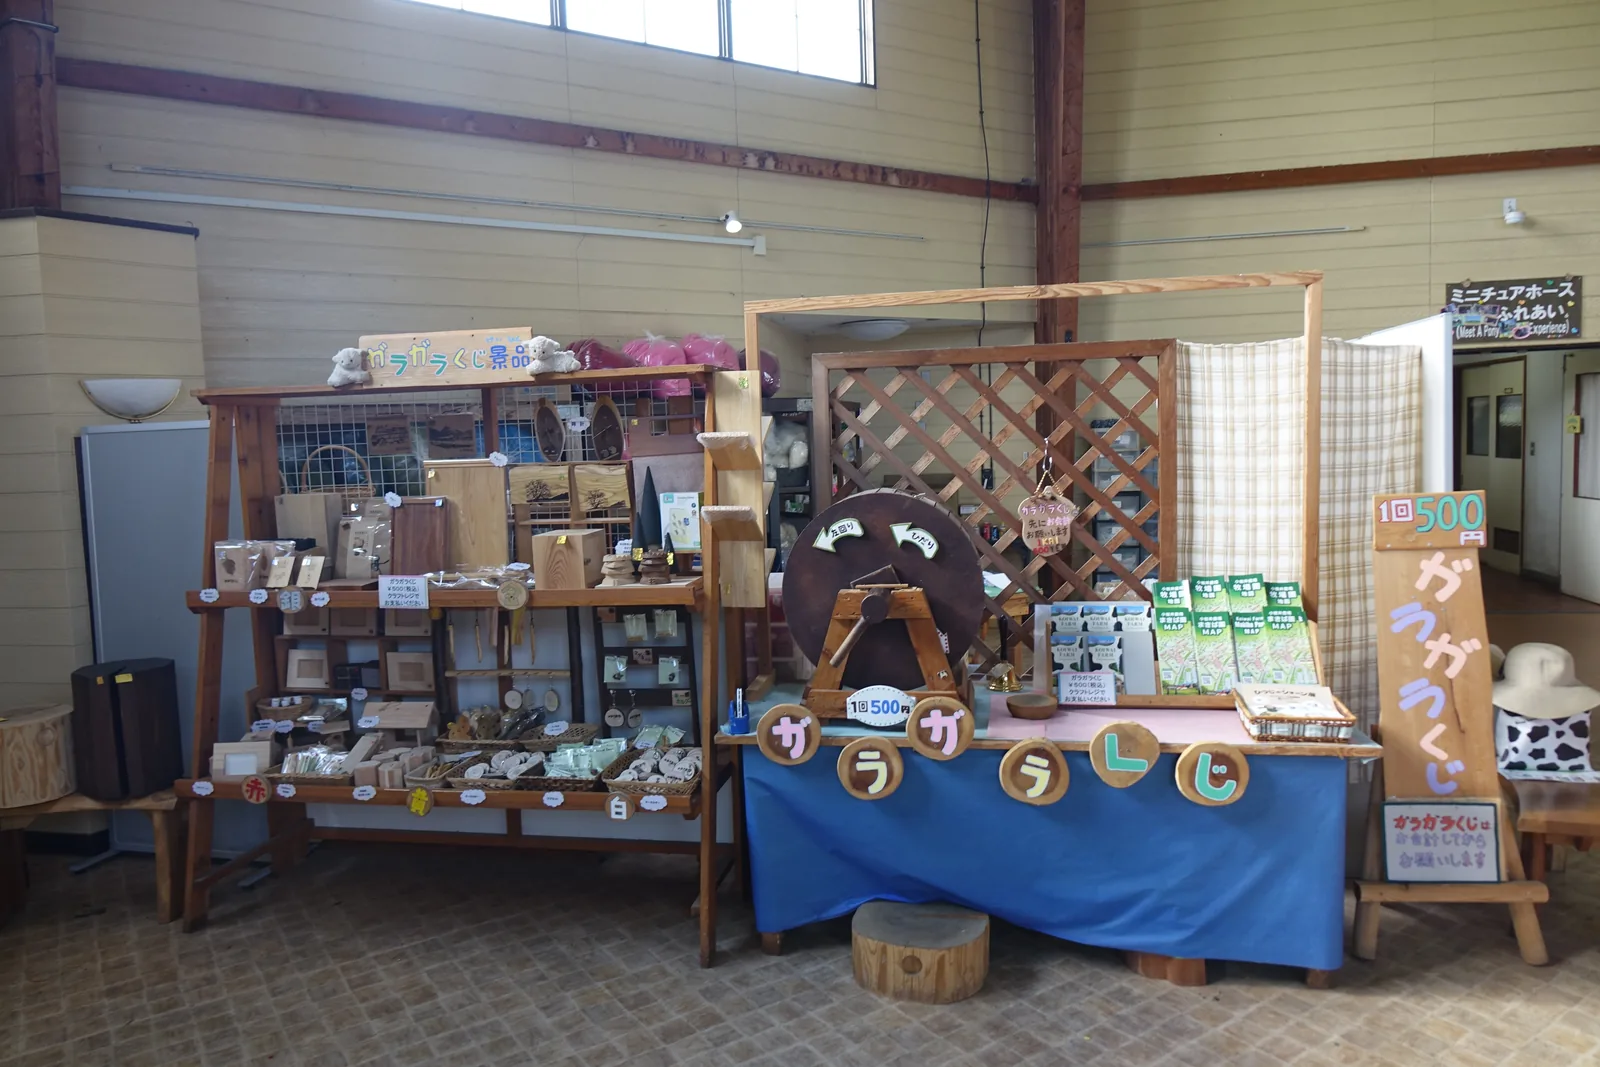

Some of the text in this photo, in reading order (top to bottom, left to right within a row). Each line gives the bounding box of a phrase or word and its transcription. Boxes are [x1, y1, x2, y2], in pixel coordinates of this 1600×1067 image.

[1451, 282, 1575, 303] ミニチュアホース
[367, 338, 530, 376] ガラガラくじ景品
[831, 521, 854, 539] 左回り
[912, 531, 935, 549] ひだり
[850, 699, 910, 714] 1回500円
[245, 775, 267, 802] 赤
[610, 796, 627, 820] 白
